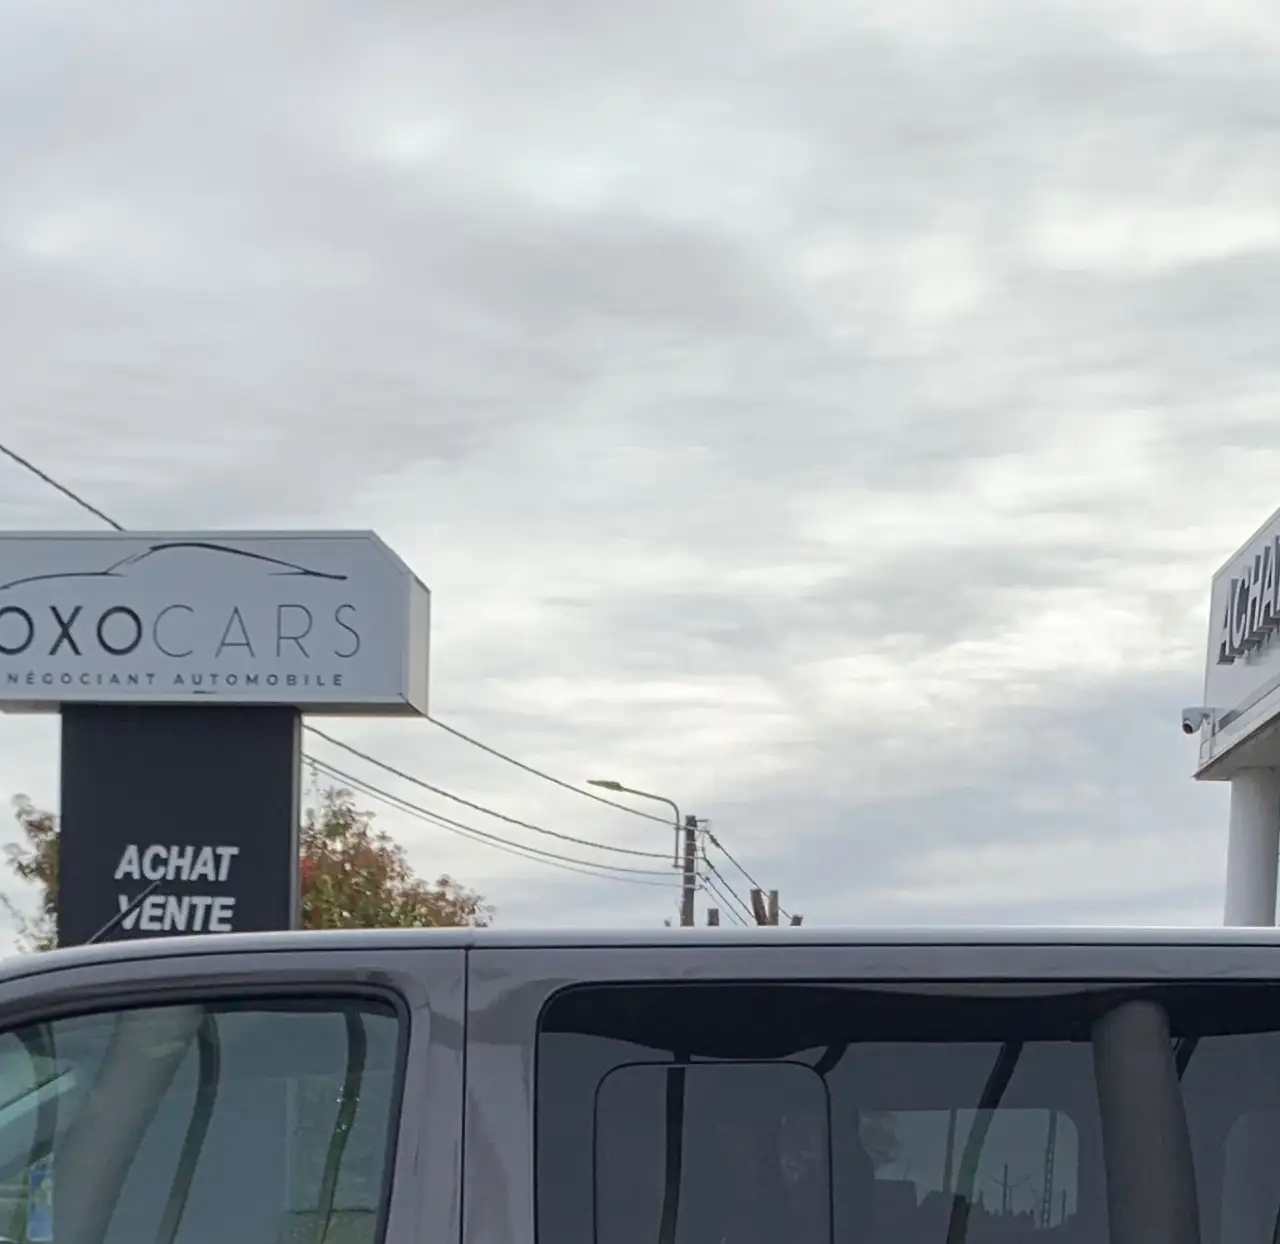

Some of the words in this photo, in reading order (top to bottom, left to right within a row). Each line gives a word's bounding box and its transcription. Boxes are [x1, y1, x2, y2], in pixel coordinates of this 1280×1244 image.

[6, 671, 156, 686] NÉGOCIANT
[173, 673, 344, 687] AUTOMOBILE
[114, 843, 240, 882] ACHAT
[118, 893, 236, 932] VENTE
